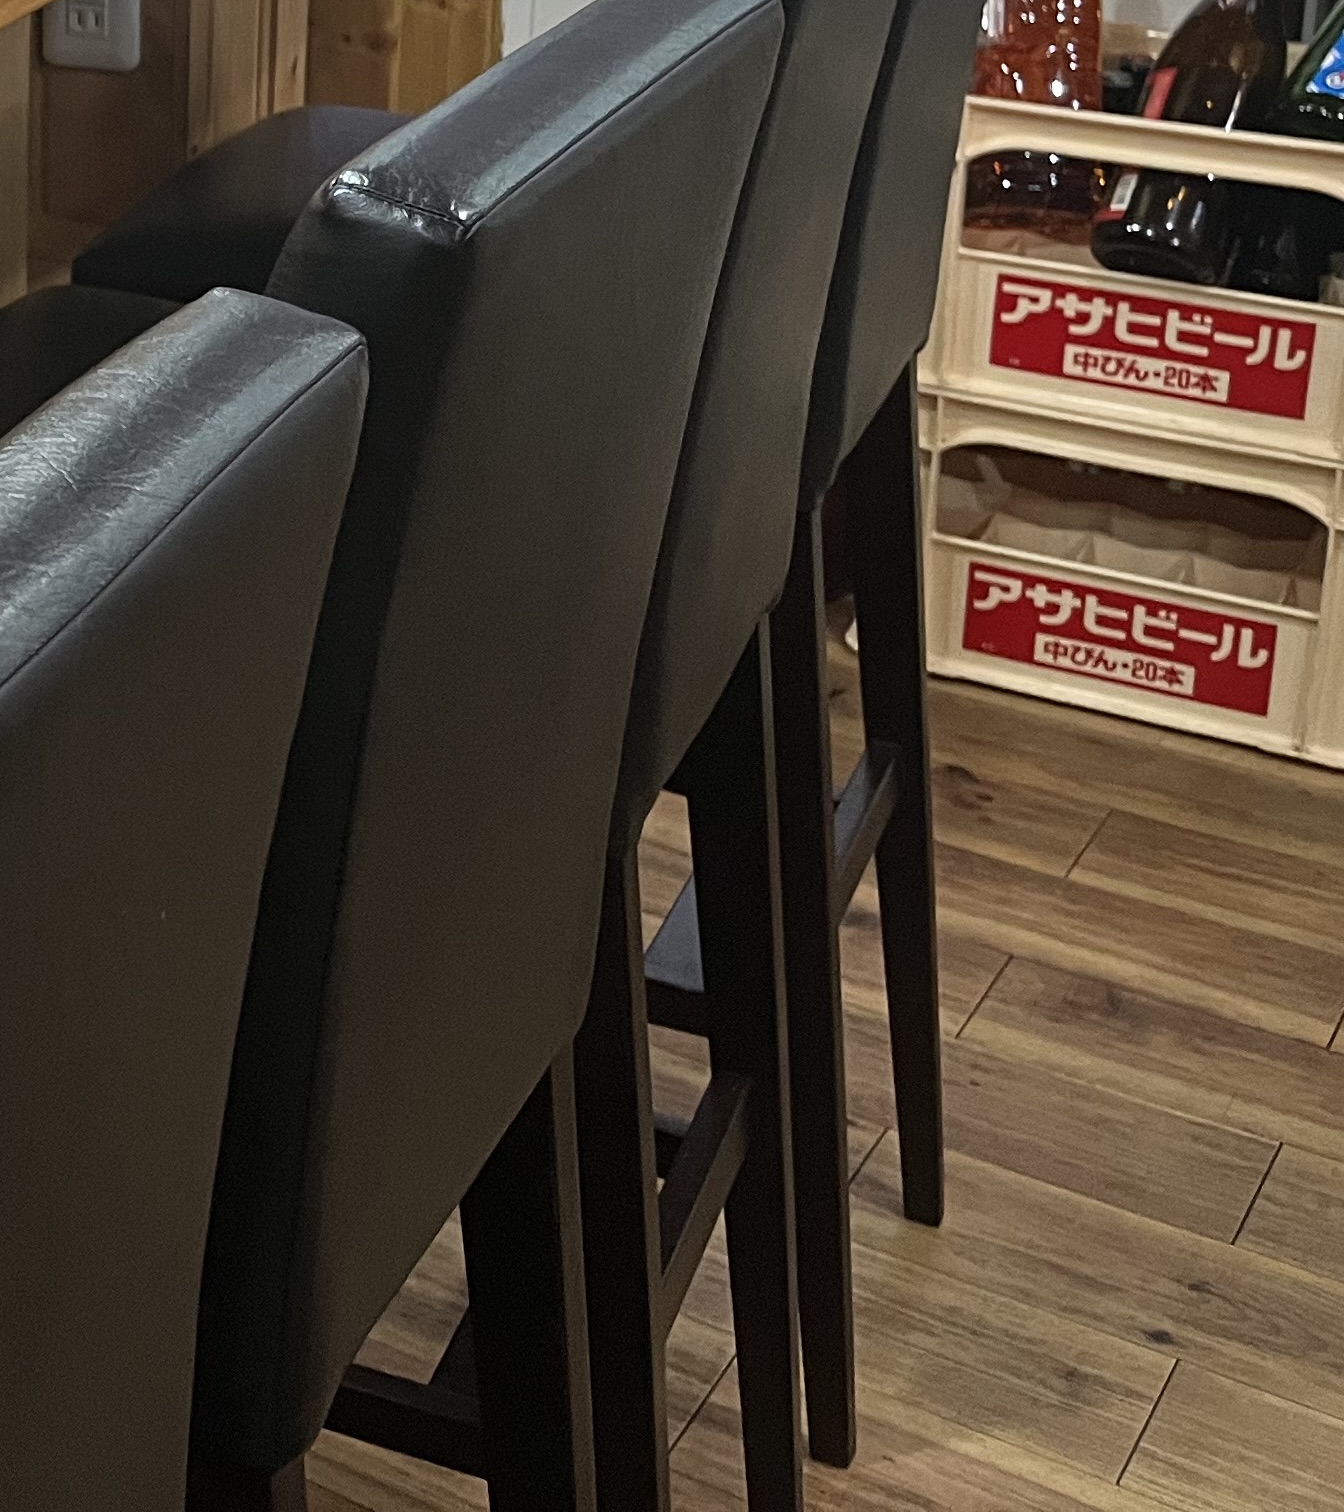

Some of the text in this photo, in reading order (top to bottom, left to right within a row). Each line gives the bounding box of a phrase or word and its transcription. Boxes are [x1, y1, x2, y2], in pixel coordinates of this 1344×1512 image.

[999, 280, 1307, 372] アサヒビール
[1072, 350, 1220, 396] 中びん・20本
[972, 569, 1270, 670] アサヒビール
[1042, 639, 1186, 688] 中びん・20本
